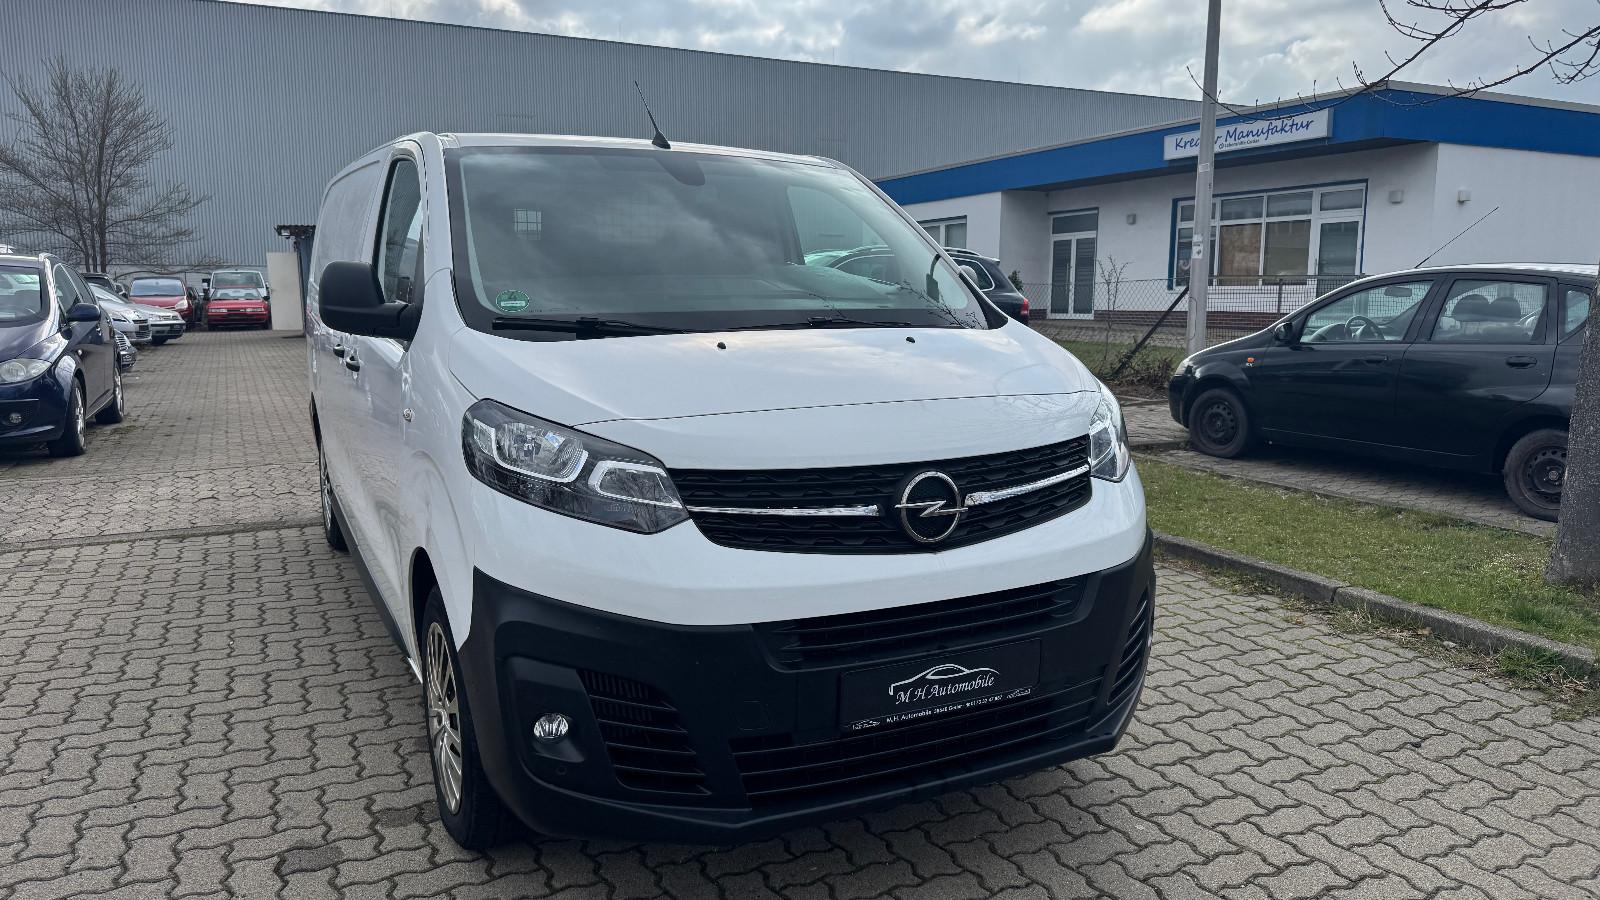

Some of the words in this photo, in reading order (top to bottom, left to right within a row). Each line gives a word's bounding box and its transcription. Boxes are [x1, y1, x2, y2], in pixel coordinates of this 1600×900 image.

[1175, 136, 1222, 151] Krea
[1225, 119, 1314, 142] Manufaktur
[896, 688, 913, 705] M
[913, 685, 929, 702] H
[927, 672, 995, 699] Automobile
[900, 710, 932, 721] Automobile
